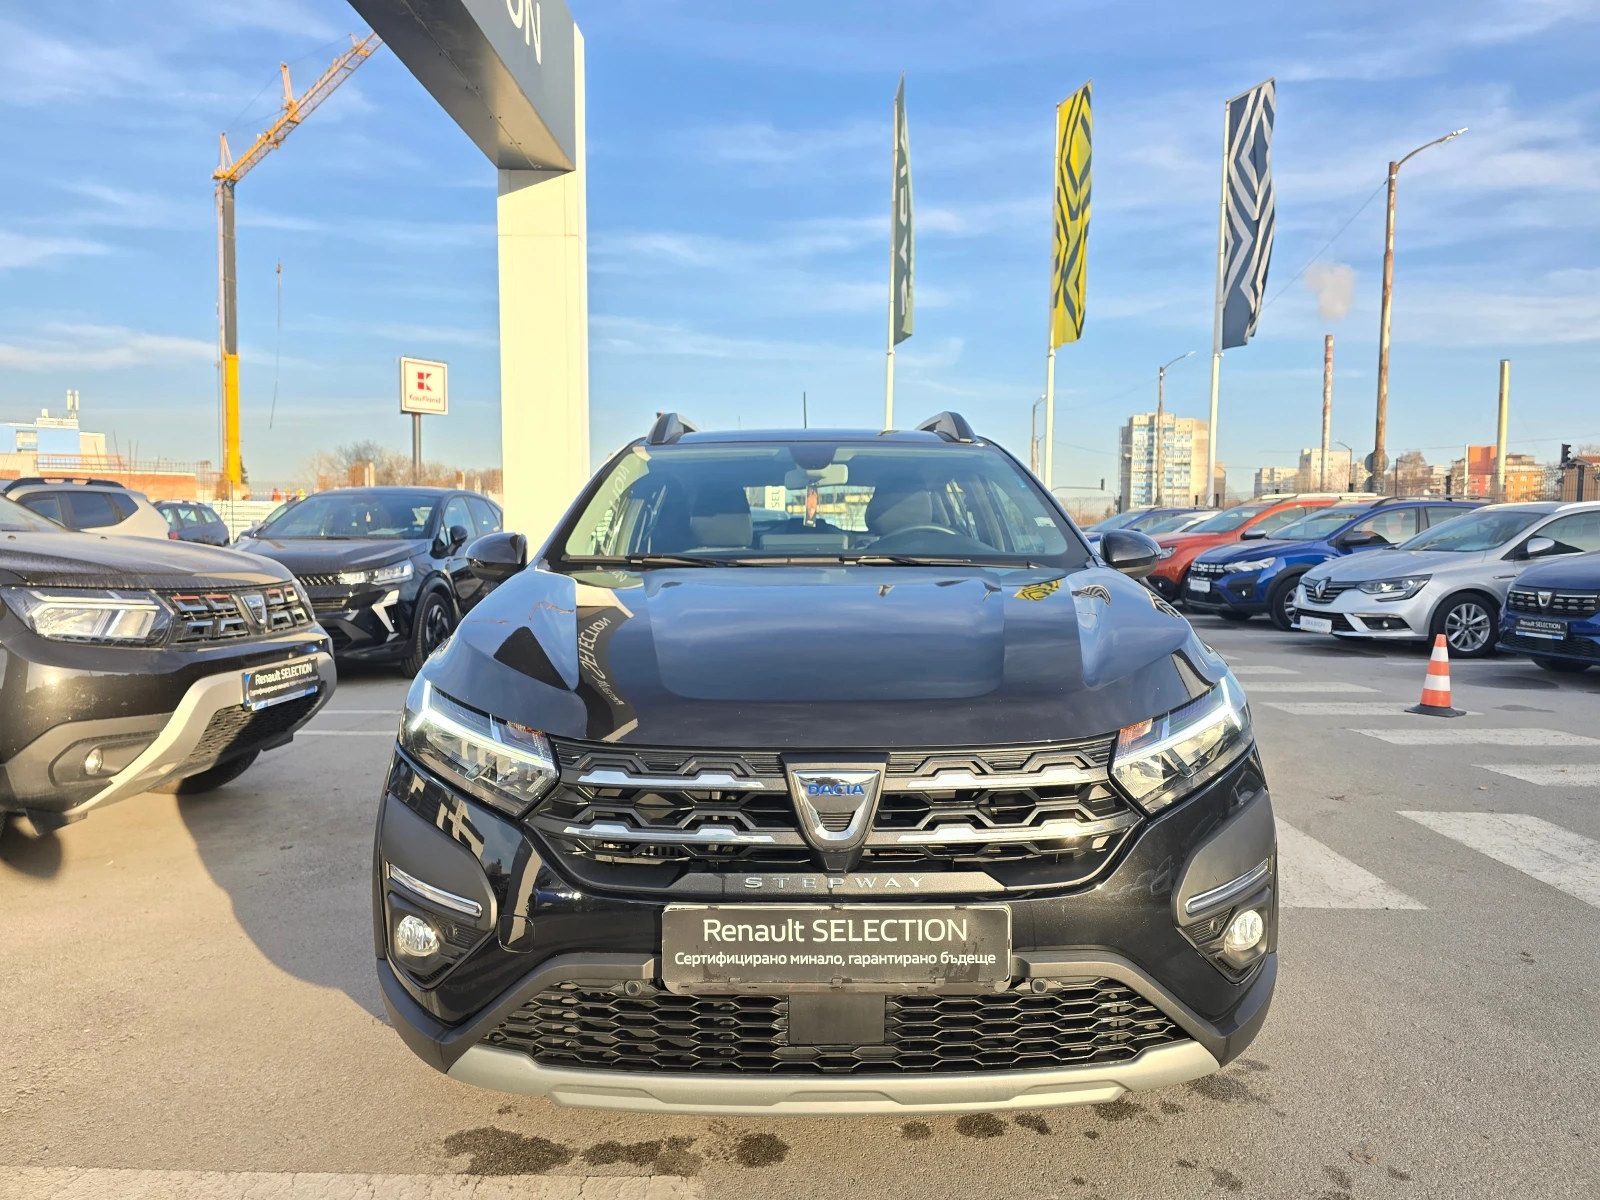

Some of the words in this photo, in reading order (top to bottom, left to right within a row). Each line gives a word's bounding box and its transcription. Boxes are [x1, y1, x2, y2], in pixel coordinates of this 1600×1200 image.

[1535, 621, 1561, 629] SELECTION
[255, 669, 281, 686] Renault
[280, 663, 312, 680] SELECTION
[807, 784, 865, 795] DACIA
[744, 877, 925, 889] STEPWAY
[703, 918, 805, 942] Renault
[812, 918, 967, 942] SELECTION
[674, 951, 787, 967] Сертифицирано
[790, 954, 846, 967] минало,
[848, 954, 937, 967] гарантирано
[940, 951, 996, 966] бъдеще
